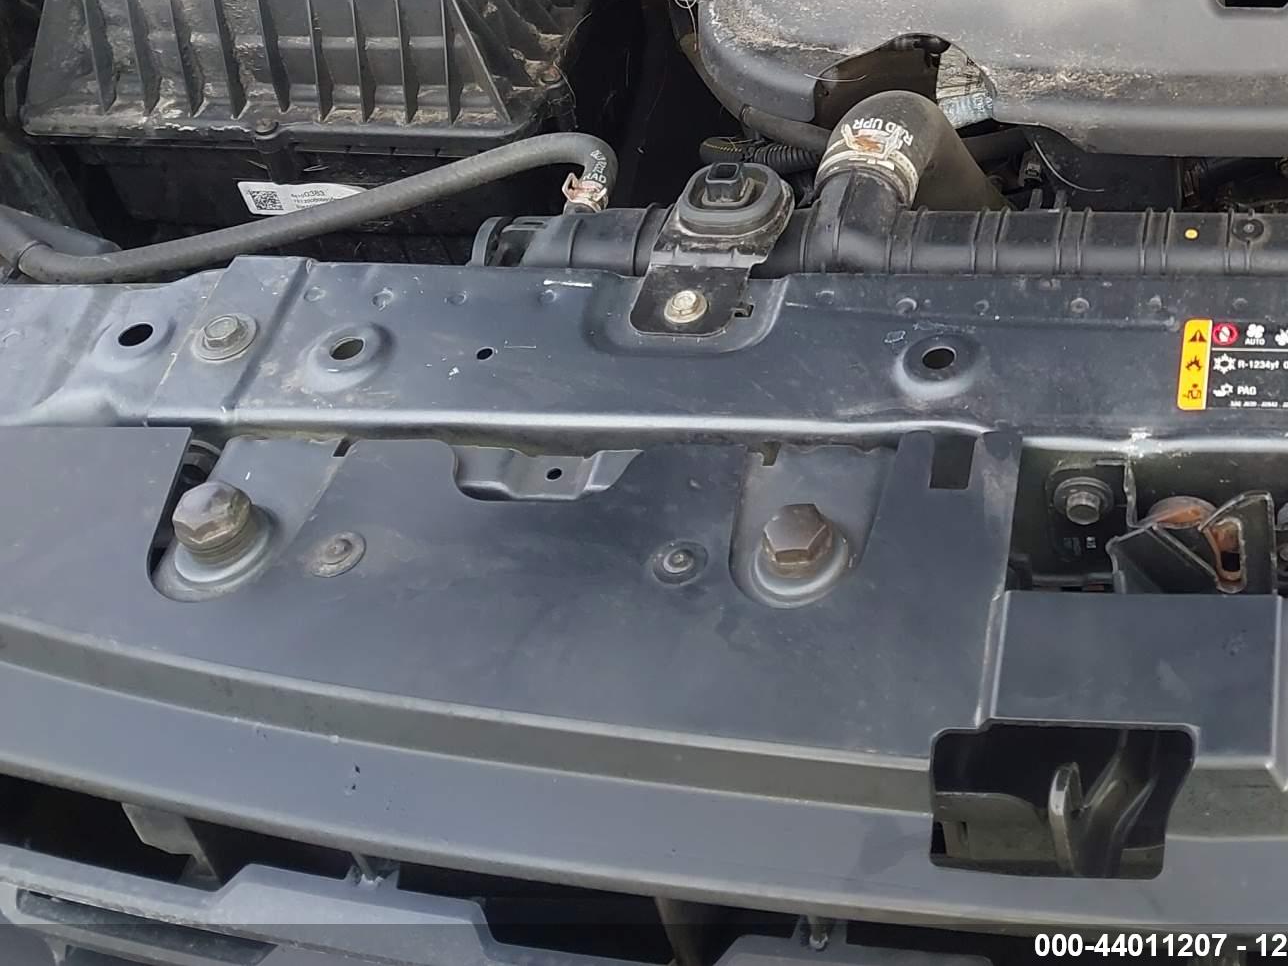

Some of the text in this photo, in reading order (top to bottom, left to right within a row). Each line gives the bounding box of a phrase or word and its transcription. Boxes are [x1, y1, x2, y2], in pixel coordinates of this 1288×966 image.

[852, 118, 884, 130] UPR
[1245, 338, 1265, 346] AUTO
[1237, 360, 1280, 371] R-1234yf
